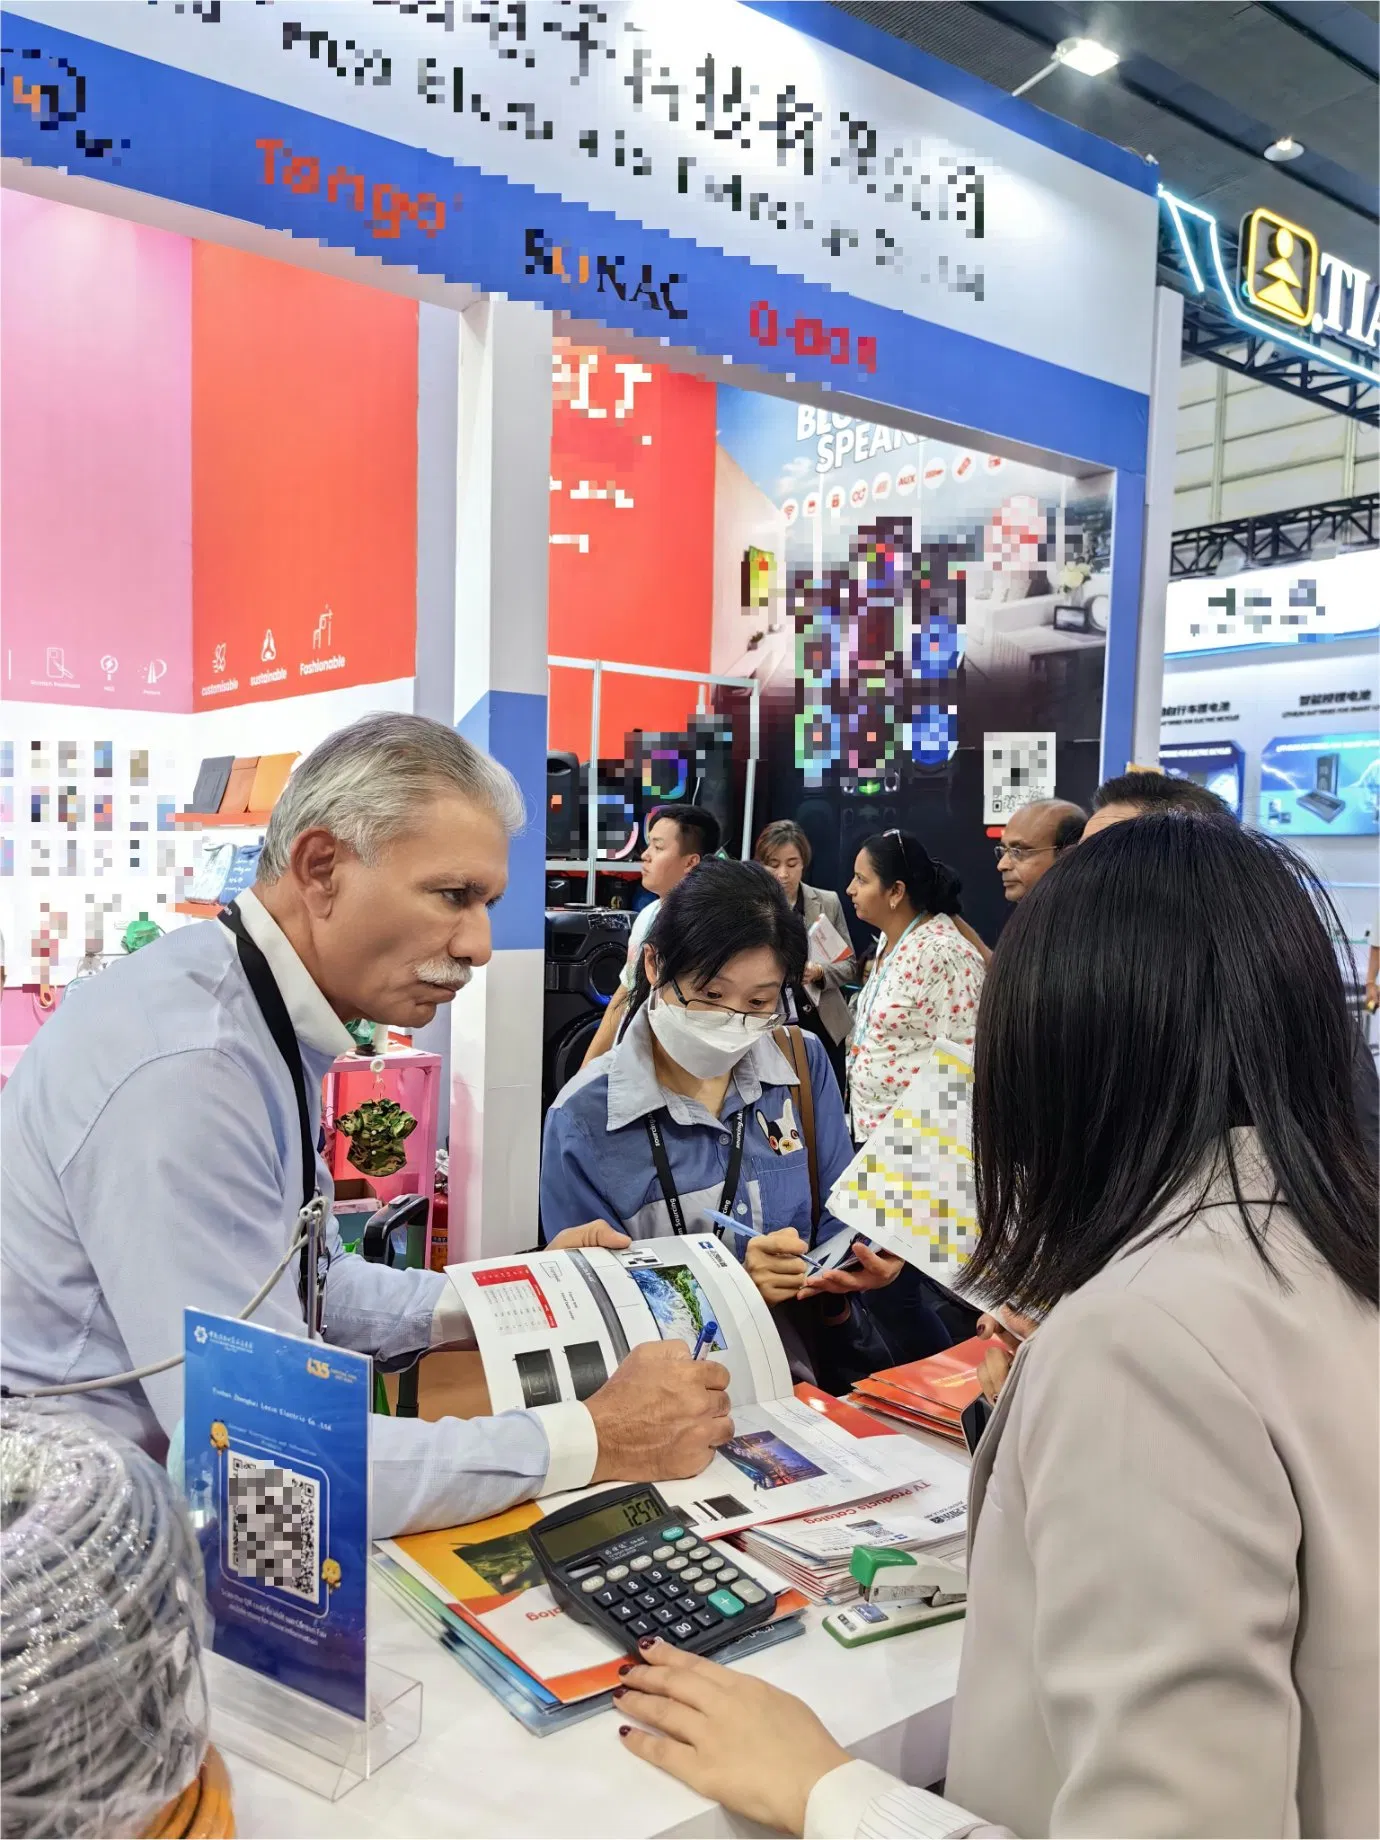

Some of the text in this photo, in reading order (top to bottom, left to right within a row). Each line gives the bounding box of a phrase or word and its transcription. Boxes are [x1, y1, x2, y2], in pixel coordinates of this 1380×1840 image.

[250, 667, 287, 686] sustainable
[300, 654, 346, 676] Fashionable
[803, 1481, 931, 1525] TV Products Catalog
[603, 1570, 663, 1601] 7 8 9
[622, 1584, 679, 1615] 4 5 6
[525, 1605, 561, 1621] alog
[638, 1598, 695, 1630] 1 2 3
[675, 1622, 692, 1633] 00
